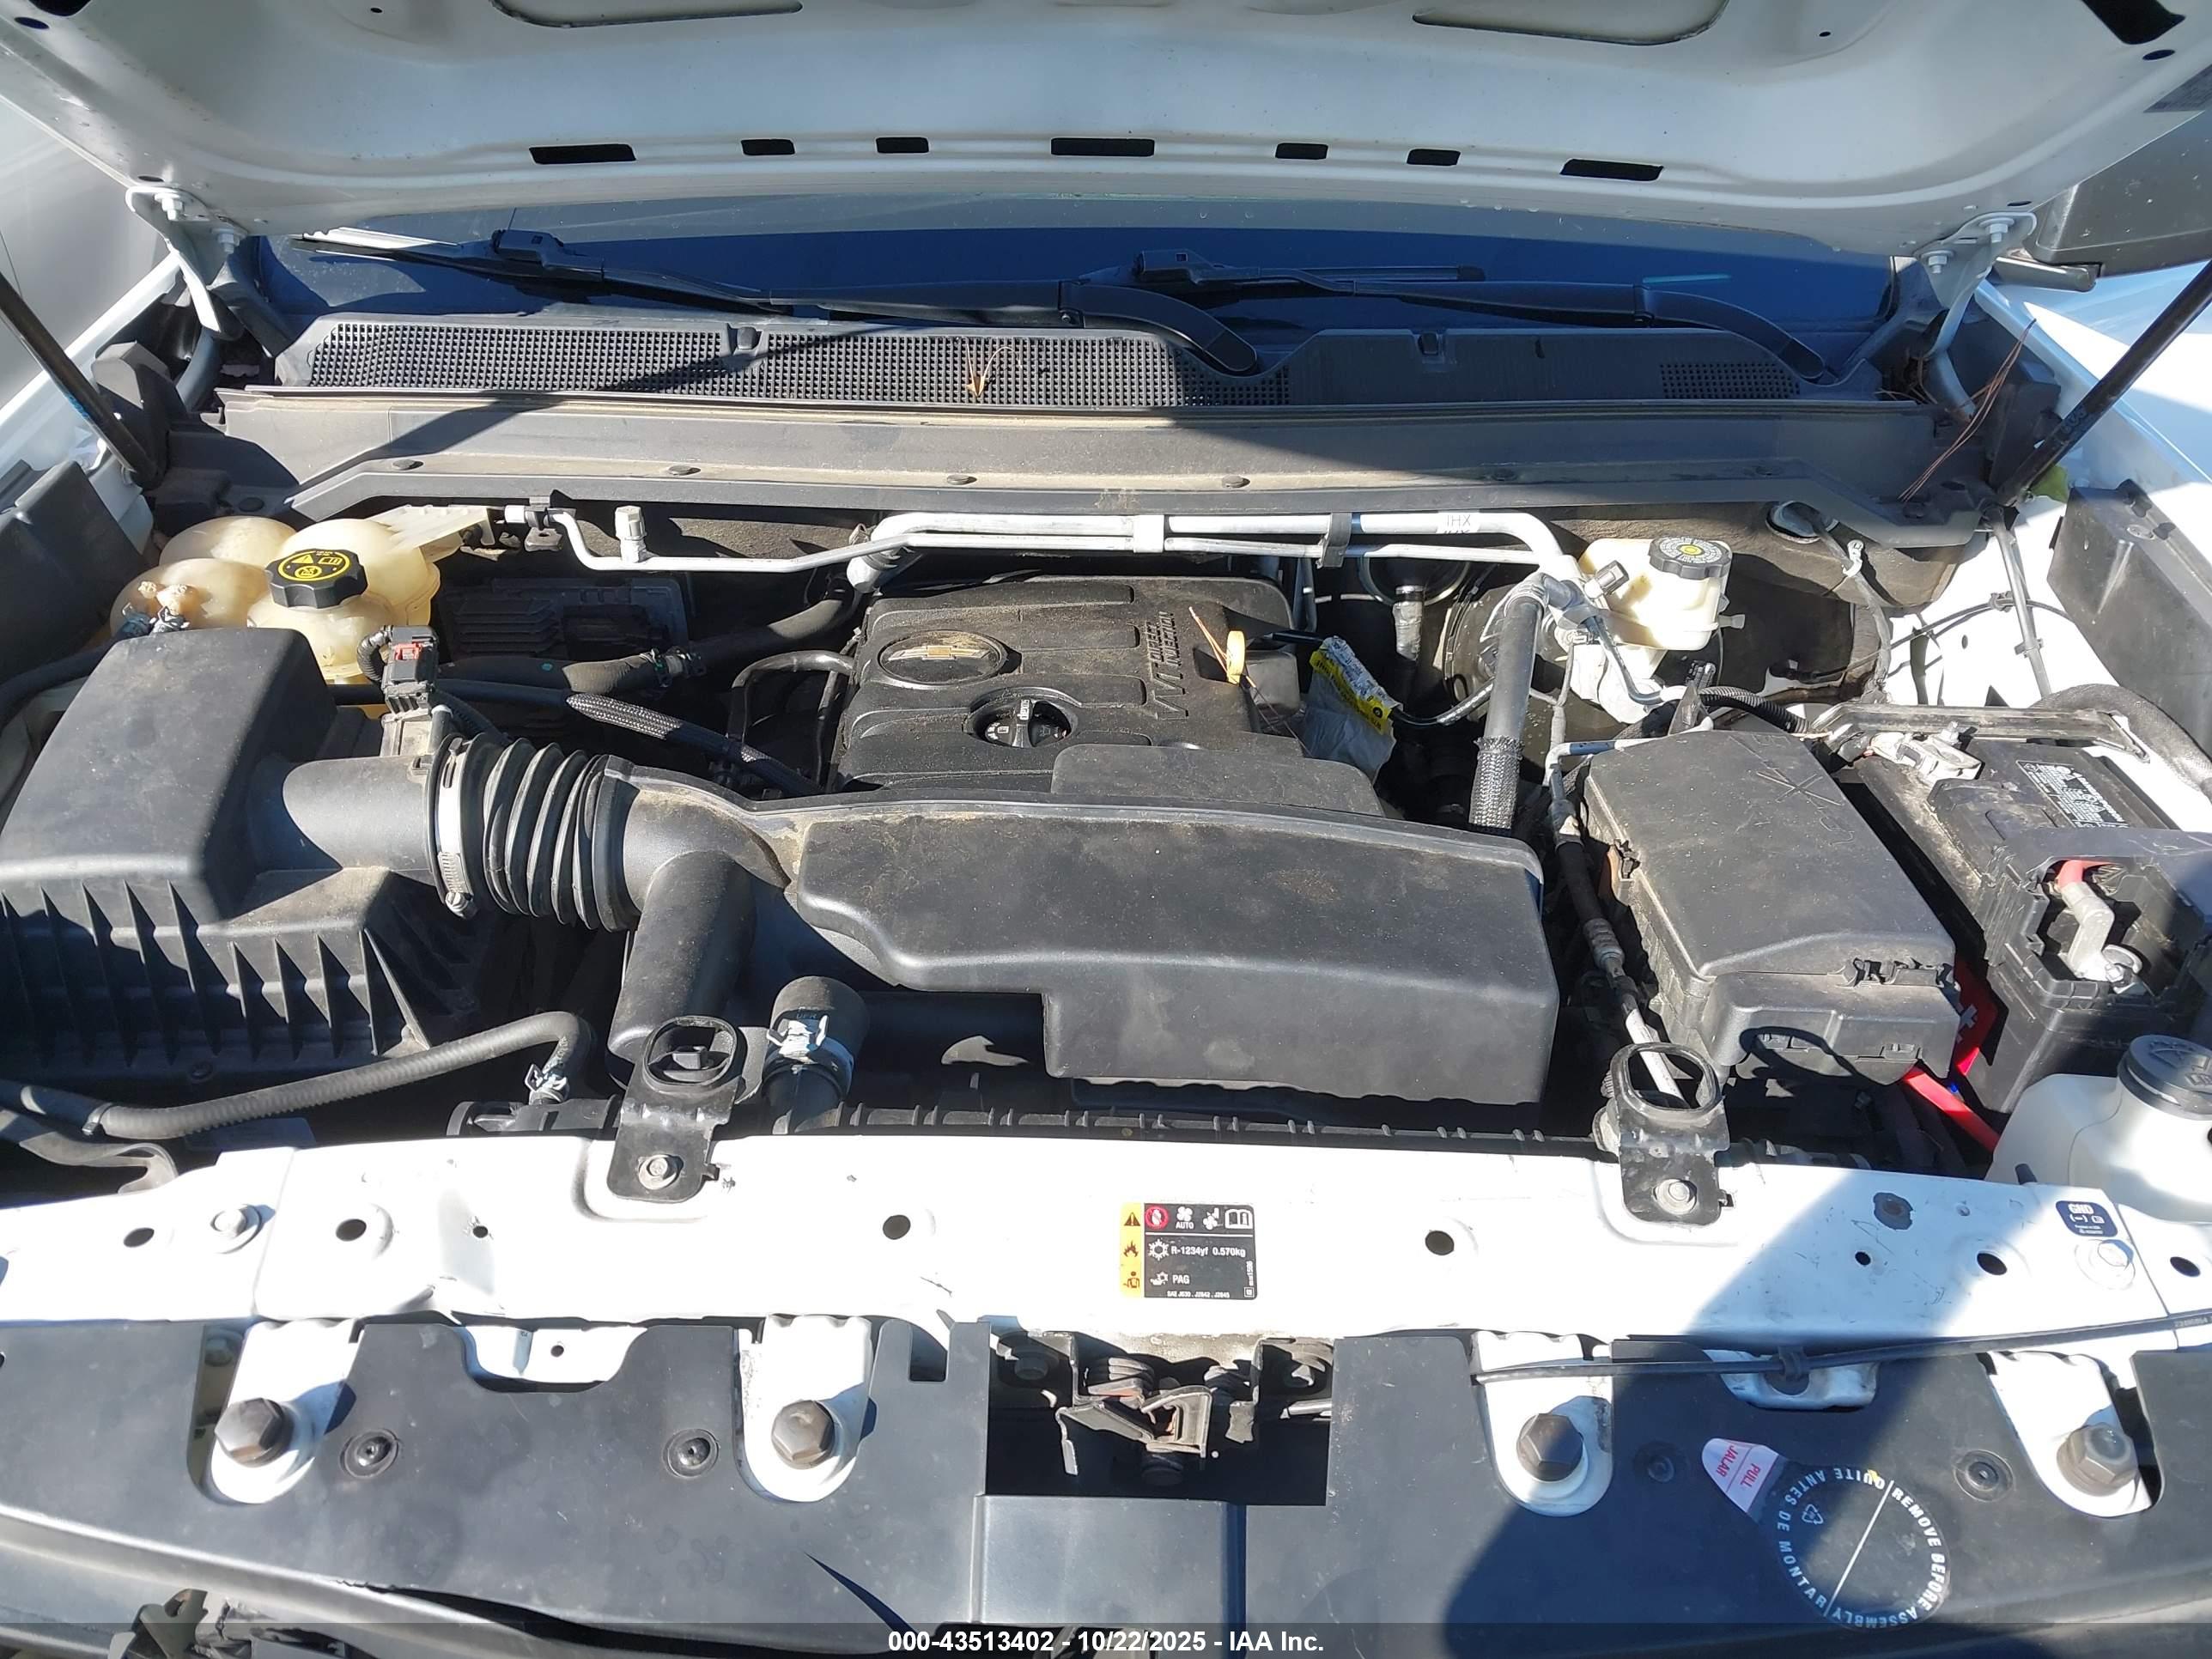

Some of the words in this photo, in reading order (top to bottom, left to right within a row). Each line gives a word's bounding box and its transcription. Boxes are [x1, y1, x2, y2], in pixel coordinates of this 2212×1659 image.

[1176, 1221, 1194, 1230] AUTO
[1170, 1246, 1209, 1257] R-1234yf
[1212, 1247, 1246, 1258] 0.570kg
[1172, 1274, 1190, 1285] PAG
[1716, 1444, 1739, 1478] JALAR
[1740, 1462, 1761, 1489] PULL
[1784, 1470, 1827, 1506] ANTES
[1833, 1467, 1886, 1491] QUITE
[1777, 1510, 1792, 1533] DE
[1891, 1486, 1942, 1548] REMOVE
[1778, 1540, 1827, 1609] MONTAR
[1917, 1553, 1946, 1613] BEFORE
[1832, 1606, 1918, 1629] ASSEMBLY
